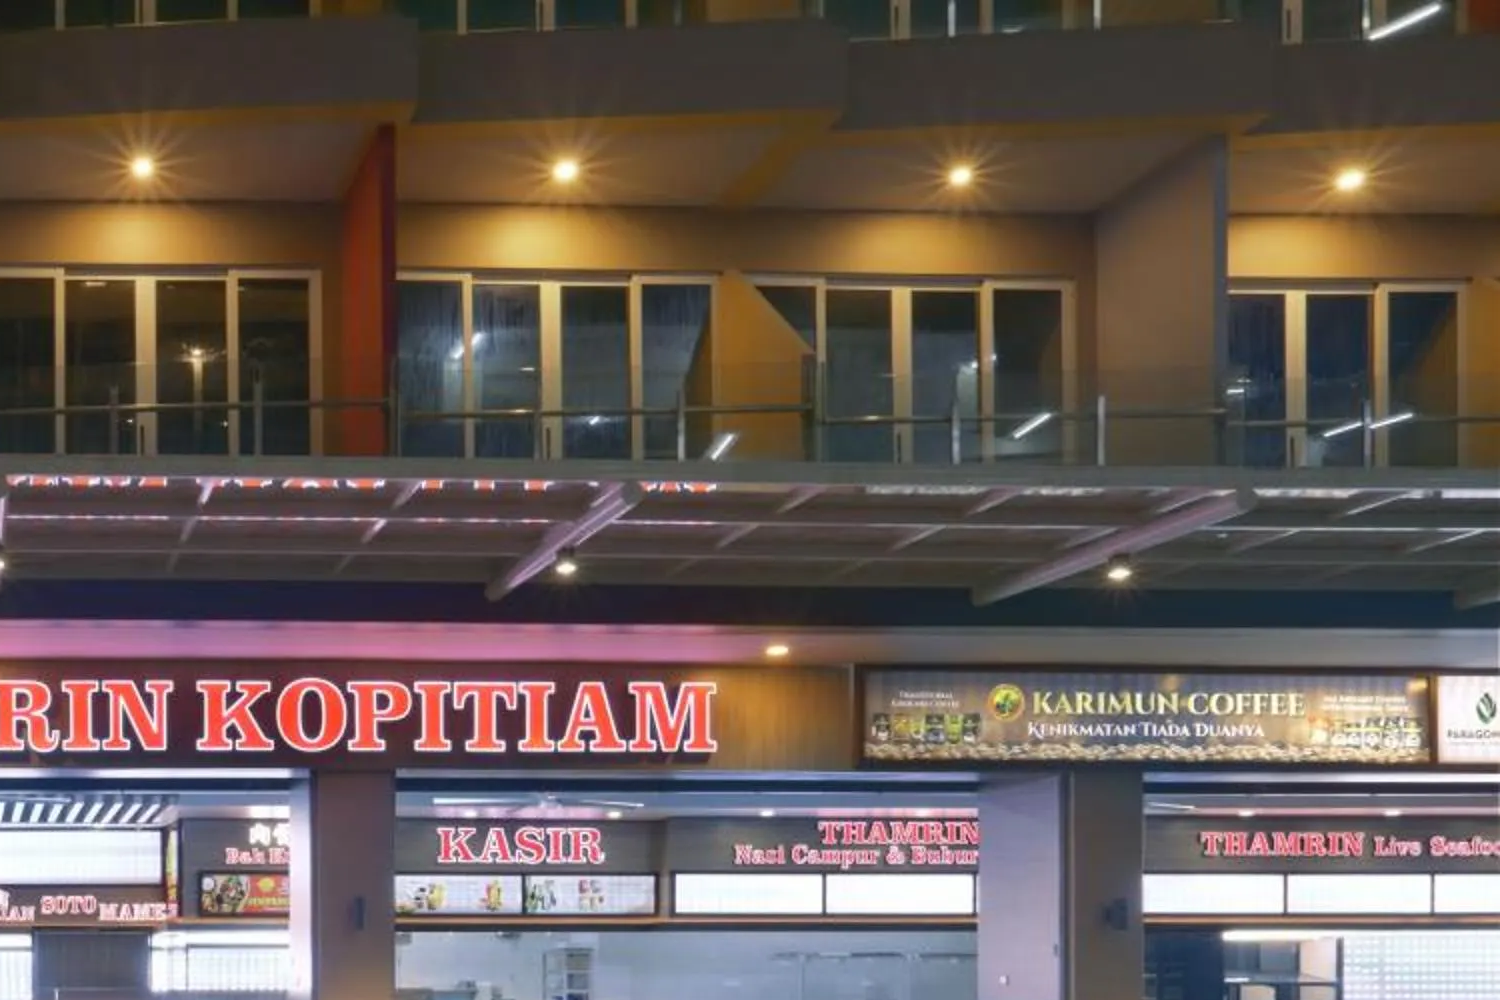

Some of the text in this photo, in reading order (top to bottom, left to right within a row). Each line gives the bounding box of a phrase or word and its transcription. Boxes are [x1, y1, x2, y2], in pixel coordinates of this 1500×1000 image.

[195, 677, 718, 755] KOPITIAM
[1032, 690, 1180, 716] KARIMUN
[1187, 691, 1306, 716] COFFEE
[1027, 720, 1265, 738] KENIKMATAN TIADA DUANYA
[436, 827, 605, 864] KASIR
[817, 820, 980, 845] THAMRIN
[1200, 831, 1365, 857] THAMRIN
[1374, 836, 1421, 857] Live
[733, 844, 786, 865] Nasi
[791, 843, 879, 870] Campur
[885, 847, 905, 865] &
[40, 895, 97, 915] SOTO
